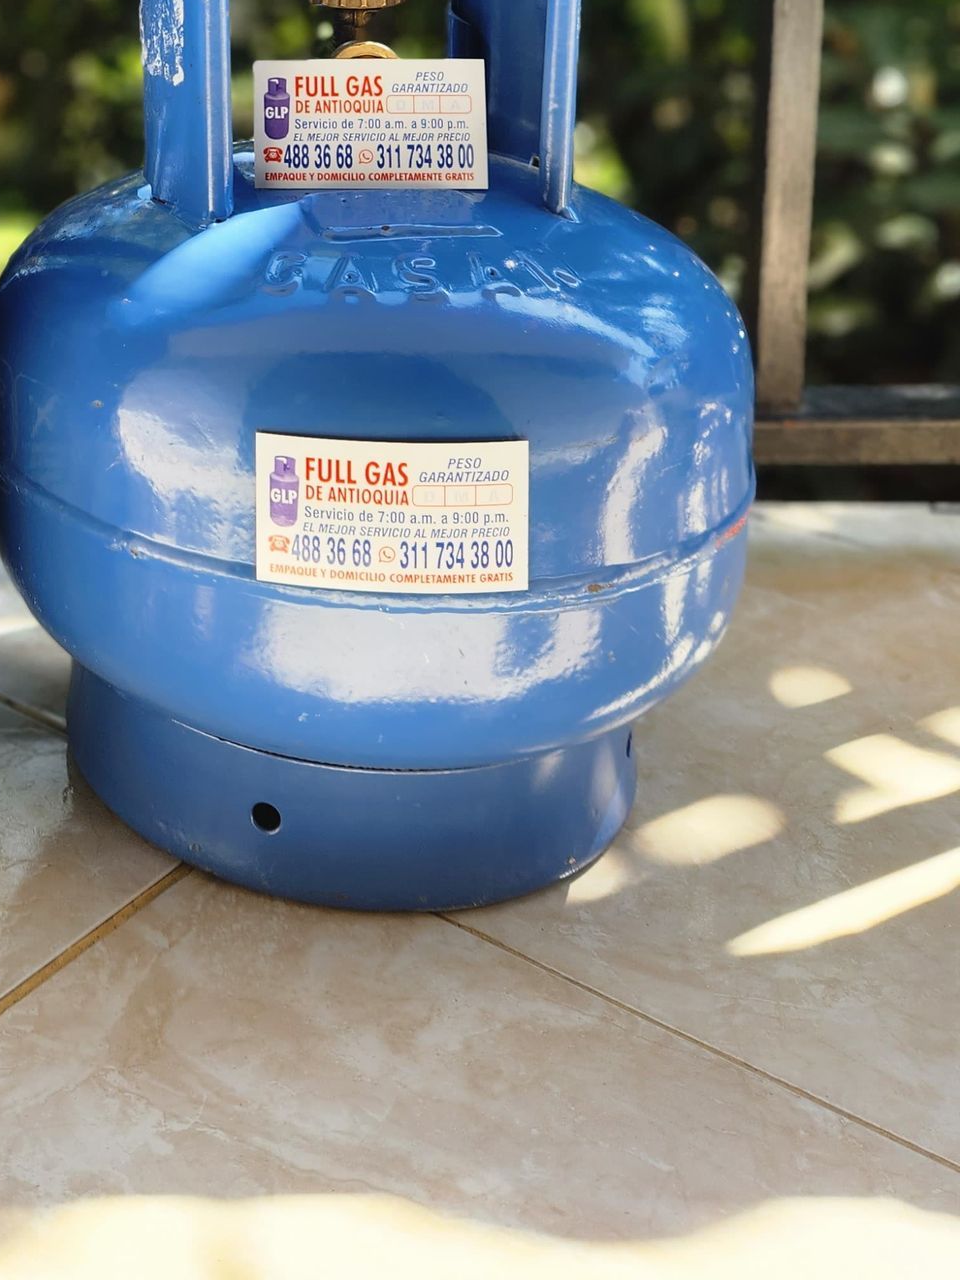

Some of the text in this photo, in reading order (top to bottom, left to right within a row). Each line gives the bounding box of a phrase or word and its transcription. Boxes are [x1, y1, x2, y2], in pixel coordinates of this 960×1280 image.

[416, 72, 444, 81] PESO
[295, 76, 383, 96] FULL GAS
[392, 84, 468, 93] GARANTIZADO
[265, 107, 288, 119] GLP
[296, 100, 384, 114] DE ANTIOQUIA
[295, 119, 469, 131] Servicio de 7:00 a.m. a 9:00 p.m.
[293, 133, 470, 141] EL MEJOR SERVICIO AL MEJOR PRECIO
[284, 145, 353, 169] 488 36 68
[377, 144, 474, 169] 311 734 38 00
[265, 173, 306, 181] EMPAQUE
[318, 173, 365, 181] DOMICILIO
[368, 173, 442, 181] COMPLETAMENTE
[445, 173, 474, 181] GRATIS
[448, 458, 481, 469] PESO
[306, 458, 408, 486] FULL GAS
[419, 471, 509, 483] GARANTIZADO
[270, 488, 297, 504] GLP
[306, 485, 409, 506] DE ANTIOQUIA
[305, 506, 508, 526] Servicio de 7:00 a.m. a 9:00 p.m.
[303, 522, 510, 538] EL MEJOR SERVICIO AL MEJOR PRECIO
[292, 534, 371, 567] 488 36 68
[400, 540, 513, 569] 311 734 38 00
[270, 564, 513, 584] EMPAQUE Y DOMICILIO COMPLETAMENTE GRATIS
